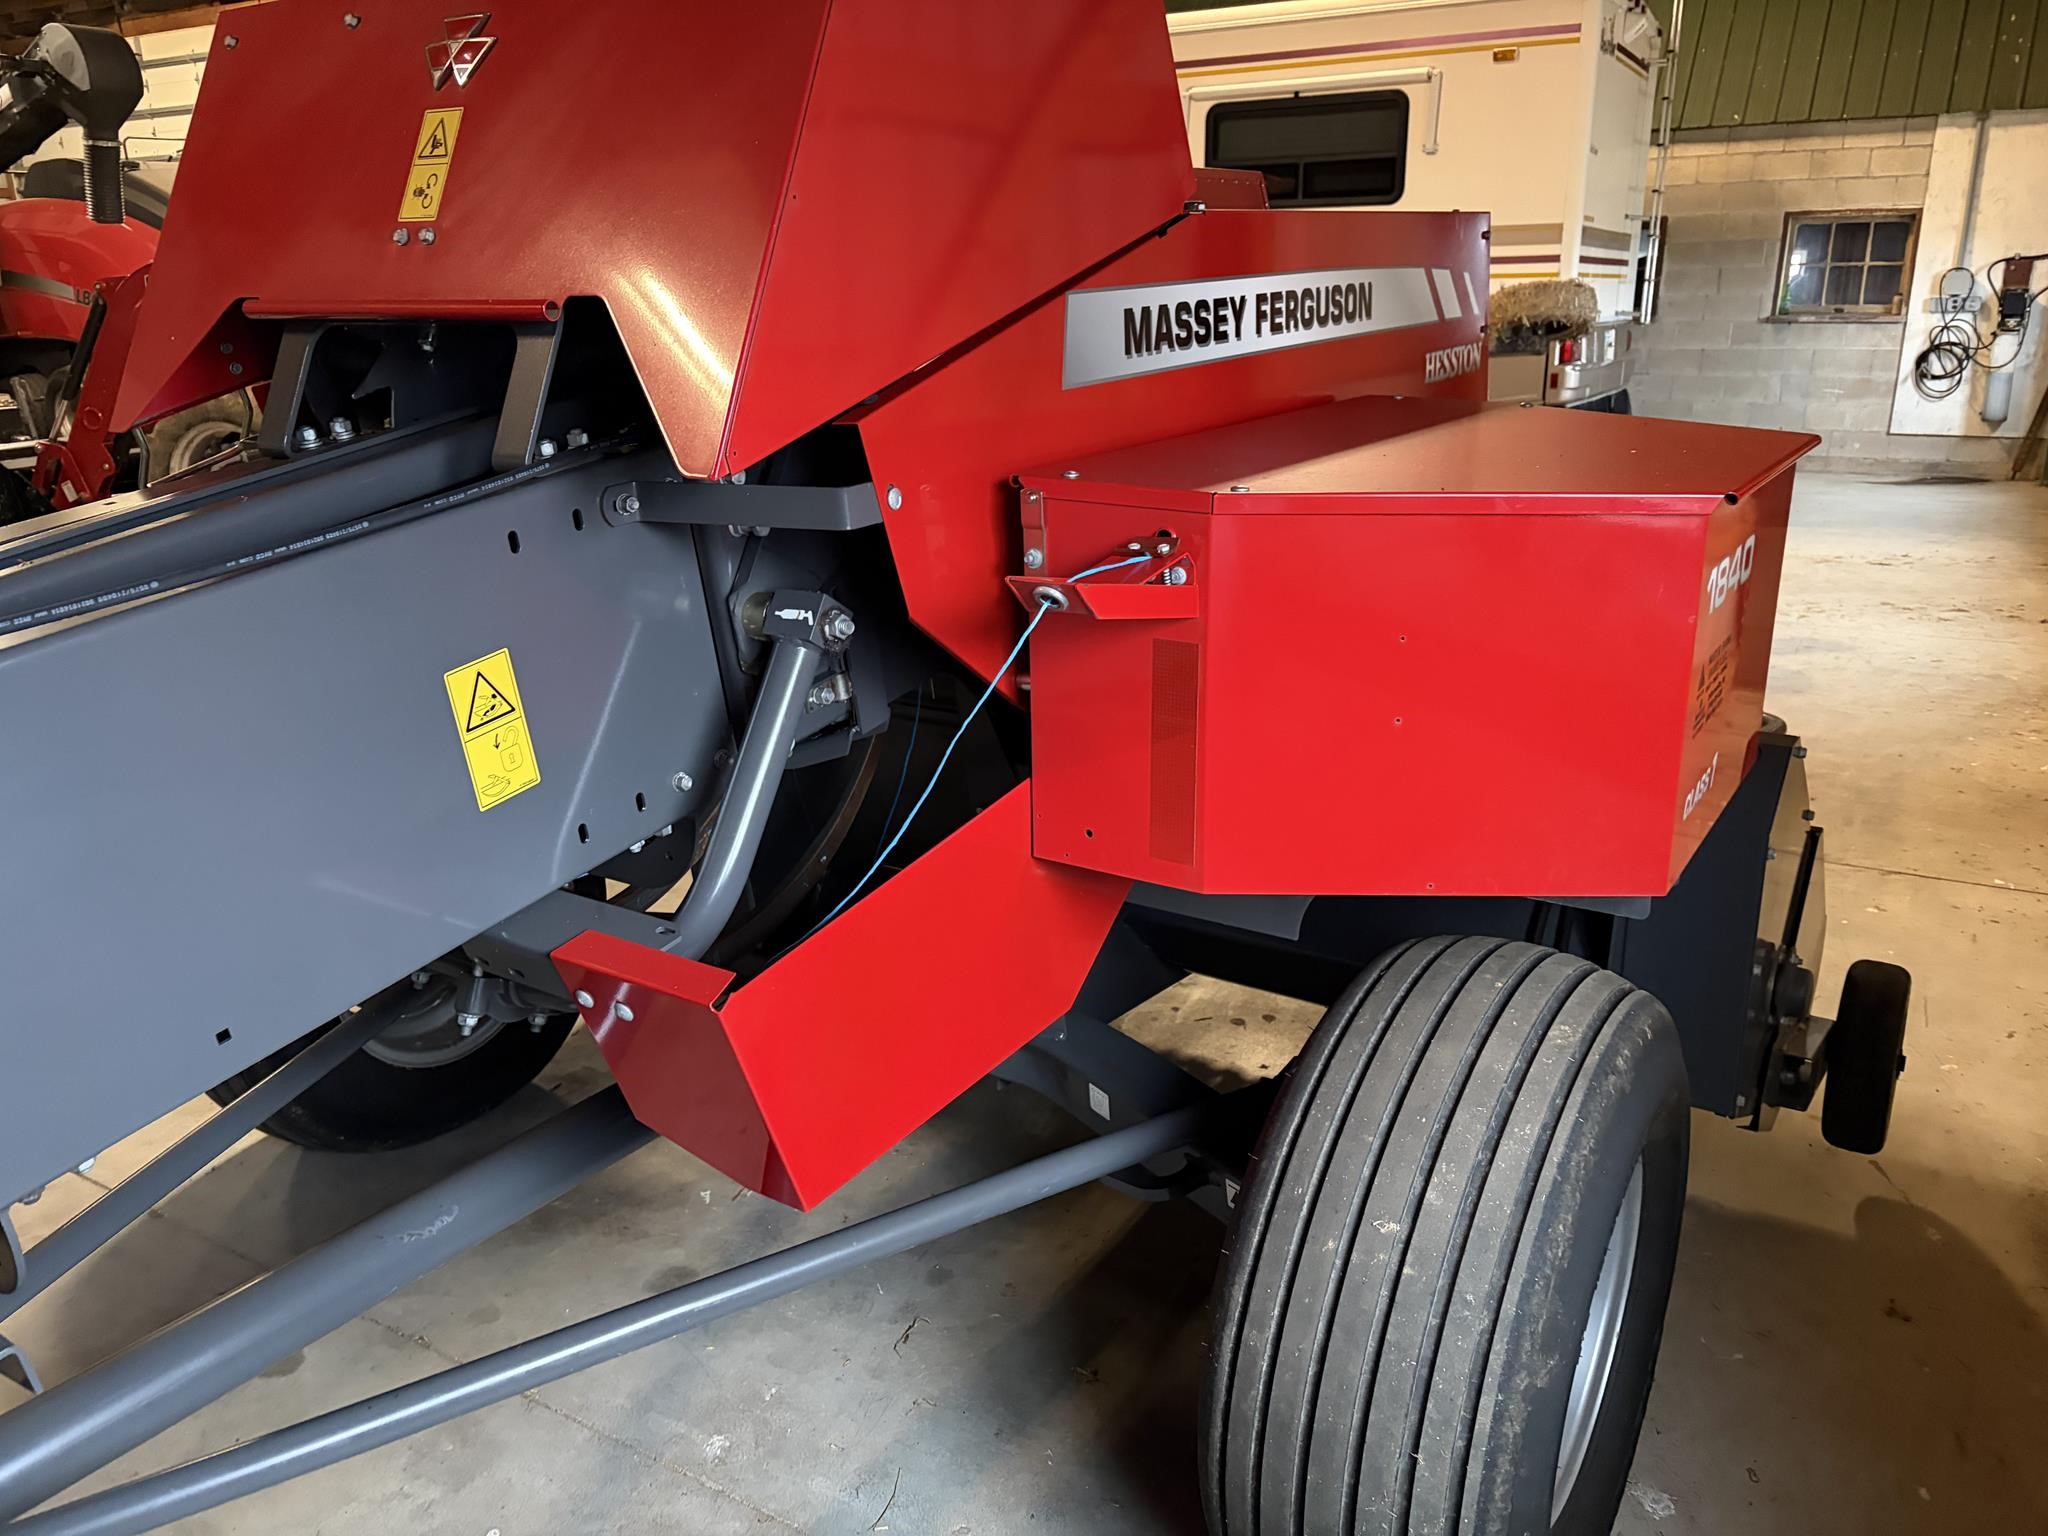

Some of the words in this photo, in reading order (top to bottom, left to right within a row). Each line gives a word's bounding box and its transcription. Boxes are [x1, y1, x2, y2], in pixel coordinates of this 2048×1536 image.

[1123, 294, 1247, 359] MASSEY
[1255, 282, 1373, 337] FERGUSON
[1425, 342, 1482, 384] HESSTON
[1707, 534, 1756, 615] 1840
[1682, 767, 1711, 821] CLASS
